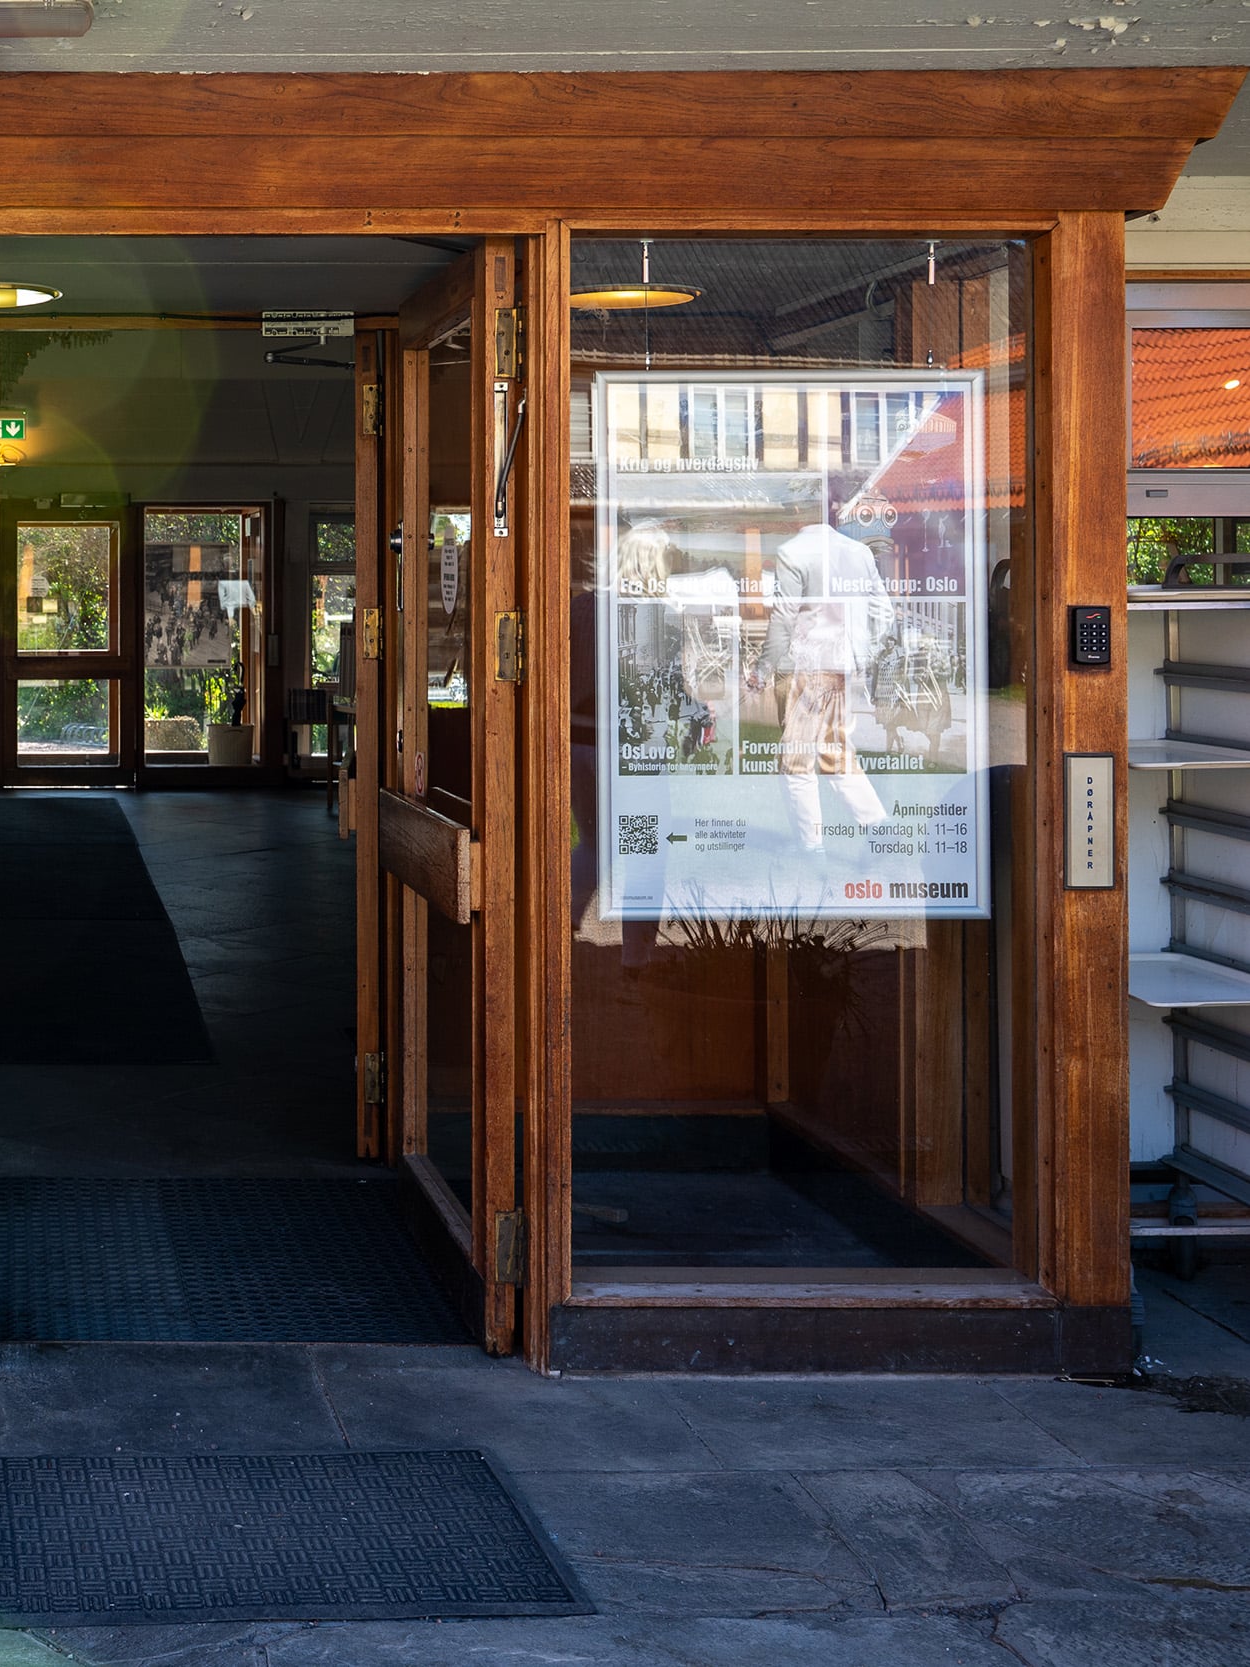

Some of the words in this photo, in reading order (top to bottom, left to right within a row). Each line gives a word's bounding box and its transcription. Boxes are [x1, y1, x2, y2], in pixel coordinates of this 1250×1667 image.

[620, 456, 648, 472] Krig
[654, 459, 670, 472] og
[620, 579, 645, 593] Fra
[832, 578, 873, 592] Neste
[878, 578, 921, 595] stopp:
[926, 578, 957, 592] Oslo
[622, 745, 674, 760] OsLove
[629, 762, 665, 772] Byhistorie
[742, 758, 778, 772] kunst
[856, 755, 923, 772] Tyvetallet
[892, 801, 967, 818] Åpningstider
[695, 818, 707, 827] Her
[710, 818, 734, 827] finner
[737, 818, 746, 827] du
[695, 830, 708, 838] alle
[711, 830, 746, 838] aktiviteter
[814, 823, 854, 838] Tirsdag
[859, 823, 868, 835] til
[872, 823, 913, 838] søndag
[918, 823, 929, 835] kl.
[935, 824, 967, 835] 11–16
[695, 843, 705, 852] og
[708, 842, 745, 852] utstillinger
[869, 841, 913, 856] Torsdag
[918, 841, 929, 853] kl.
[935, 842, 967, 853] 11–18
[845, 880, 882, 899] oslo
[889, 882, 968, 899] museum
